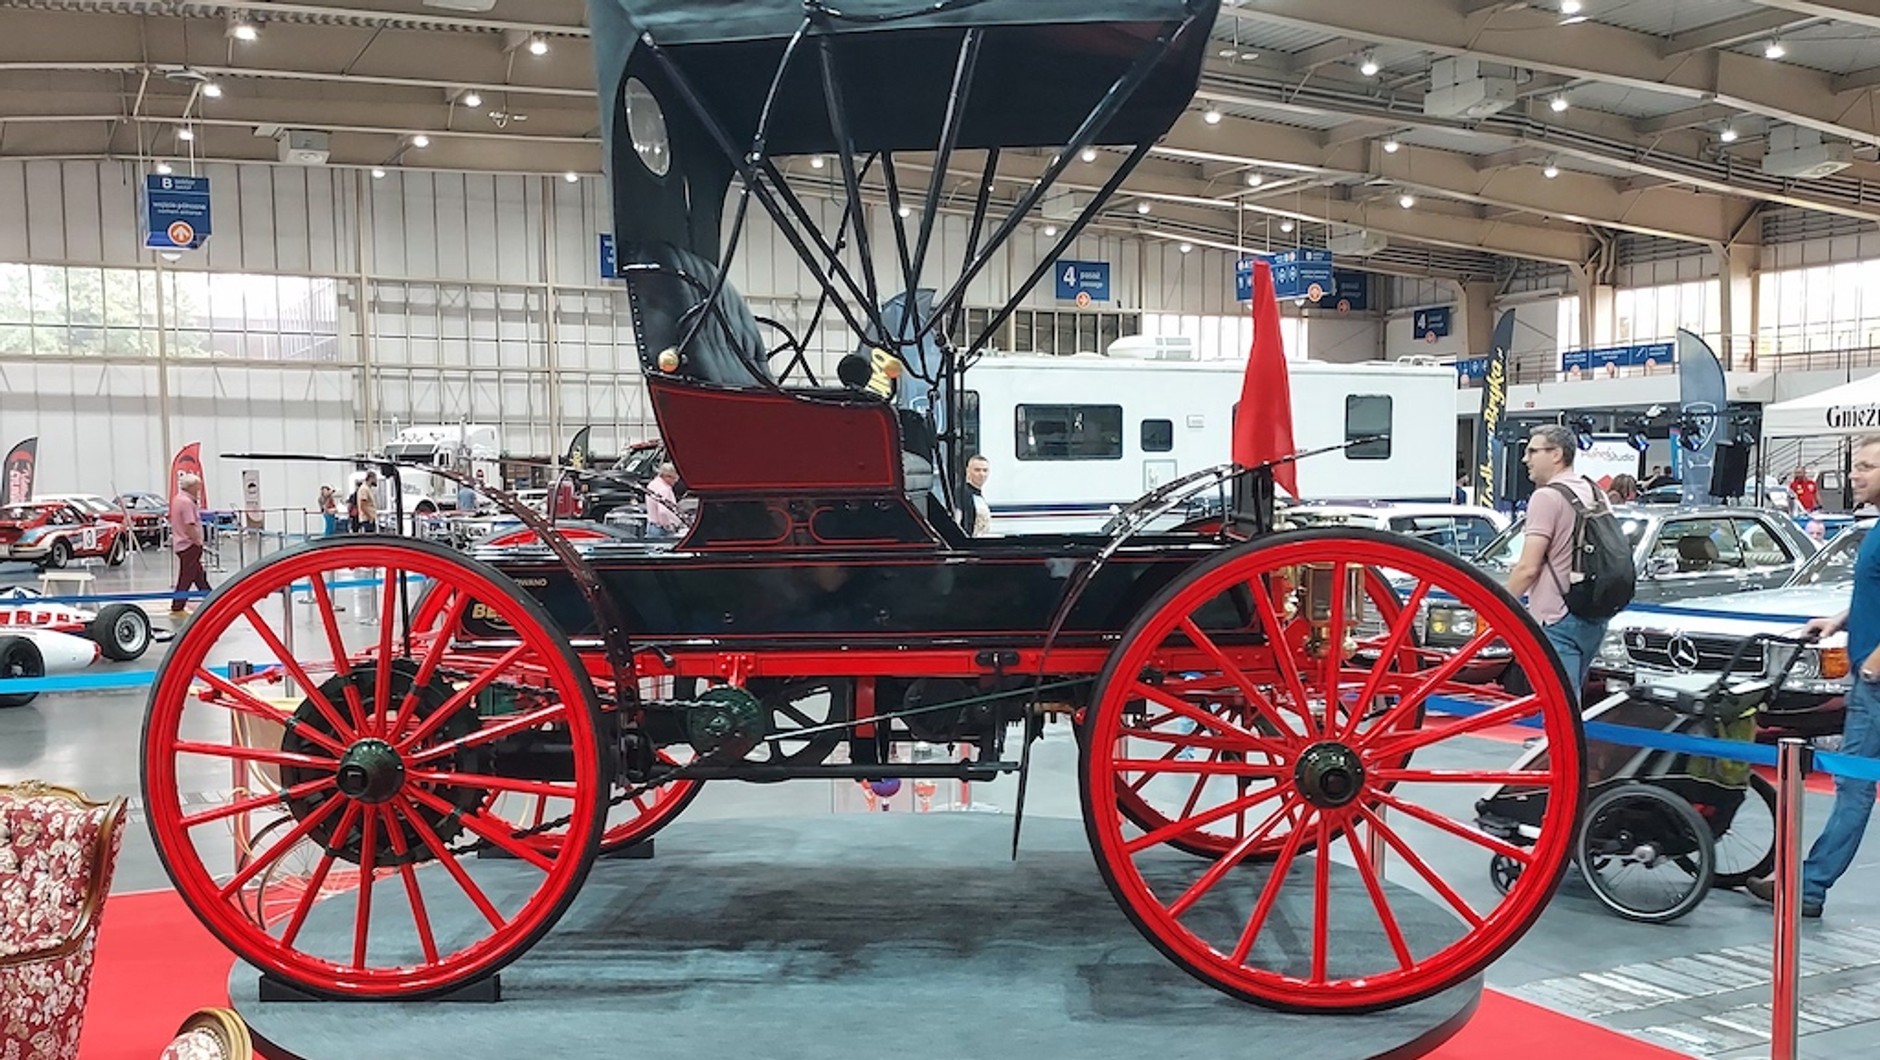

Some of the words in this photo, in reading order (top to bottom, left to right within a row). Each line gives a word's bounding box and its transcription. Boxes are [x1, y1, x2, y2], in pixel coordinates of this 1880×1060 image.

[162, 178, 173, 189] B
[1063, 265, 1077, 287] 4
[1417, 313, 1427, 330] 4
[1826, 401, 1880, 429] Gnieź
